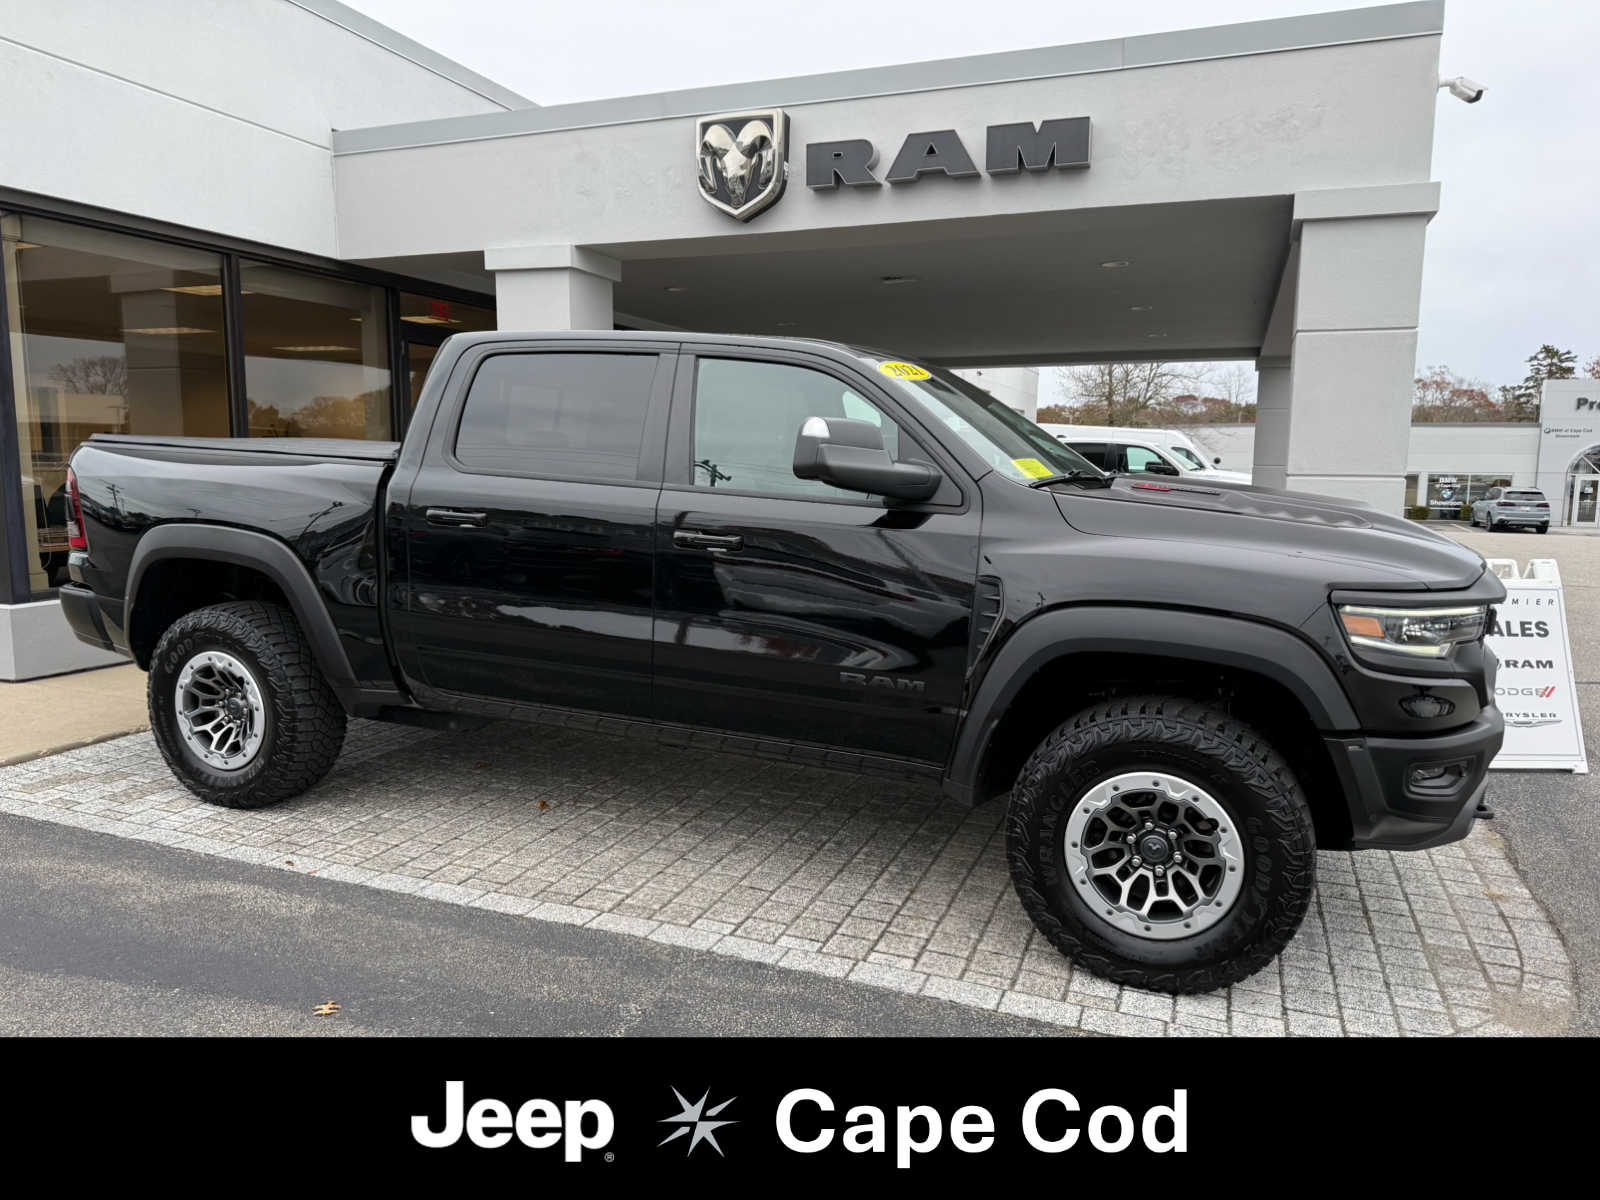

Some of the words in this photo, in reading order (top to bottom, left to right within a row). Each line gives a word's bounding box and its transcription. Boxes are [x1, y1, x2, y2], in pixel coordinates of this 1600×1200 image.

[806, 116, 1091, 191] RAM
[1511, 598, 1554, 606] MIER
[1490, 621, 1549, 638] ALES
[1505, 659, 1554, 669] RAM
[840, 671, 925, 692] RAM
[1495, 687, 1545, 697] ODGE
